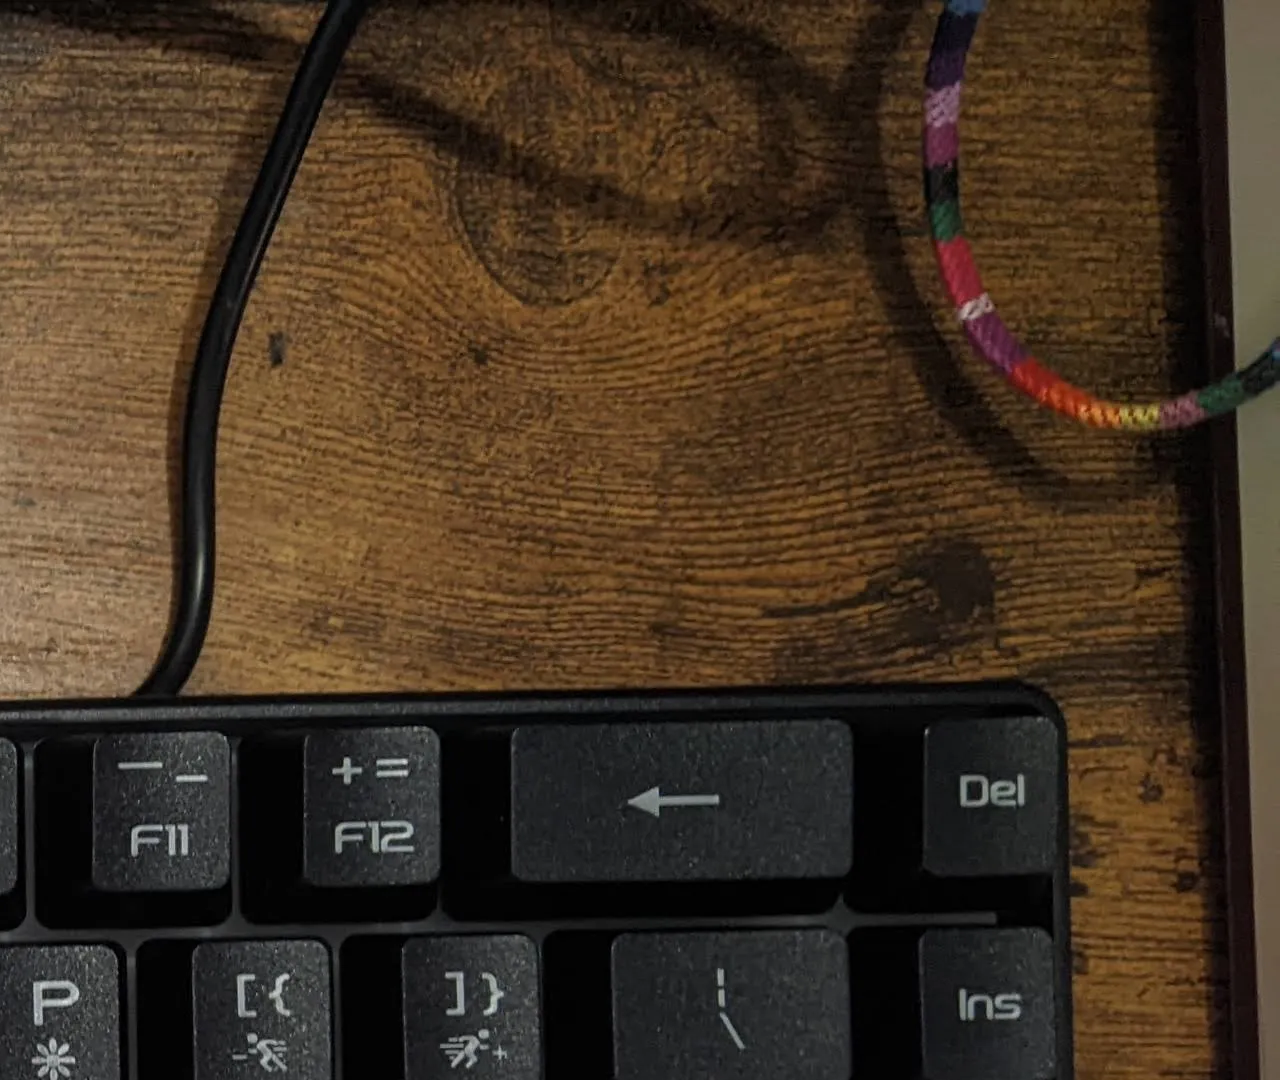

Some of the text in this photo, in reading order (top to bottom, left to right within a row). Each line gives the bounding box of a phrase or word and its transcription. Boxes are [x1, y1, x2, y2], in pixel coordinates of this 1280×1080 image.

[332, 757, 409, 785] + =
[960, 773, 1026, 807] Del
[130, 823, 189, 857] F11
[335, 820, 415, 853] F12
[32, 980, 80, 1026] P
[959, 988, 1022, 1020] Ins
